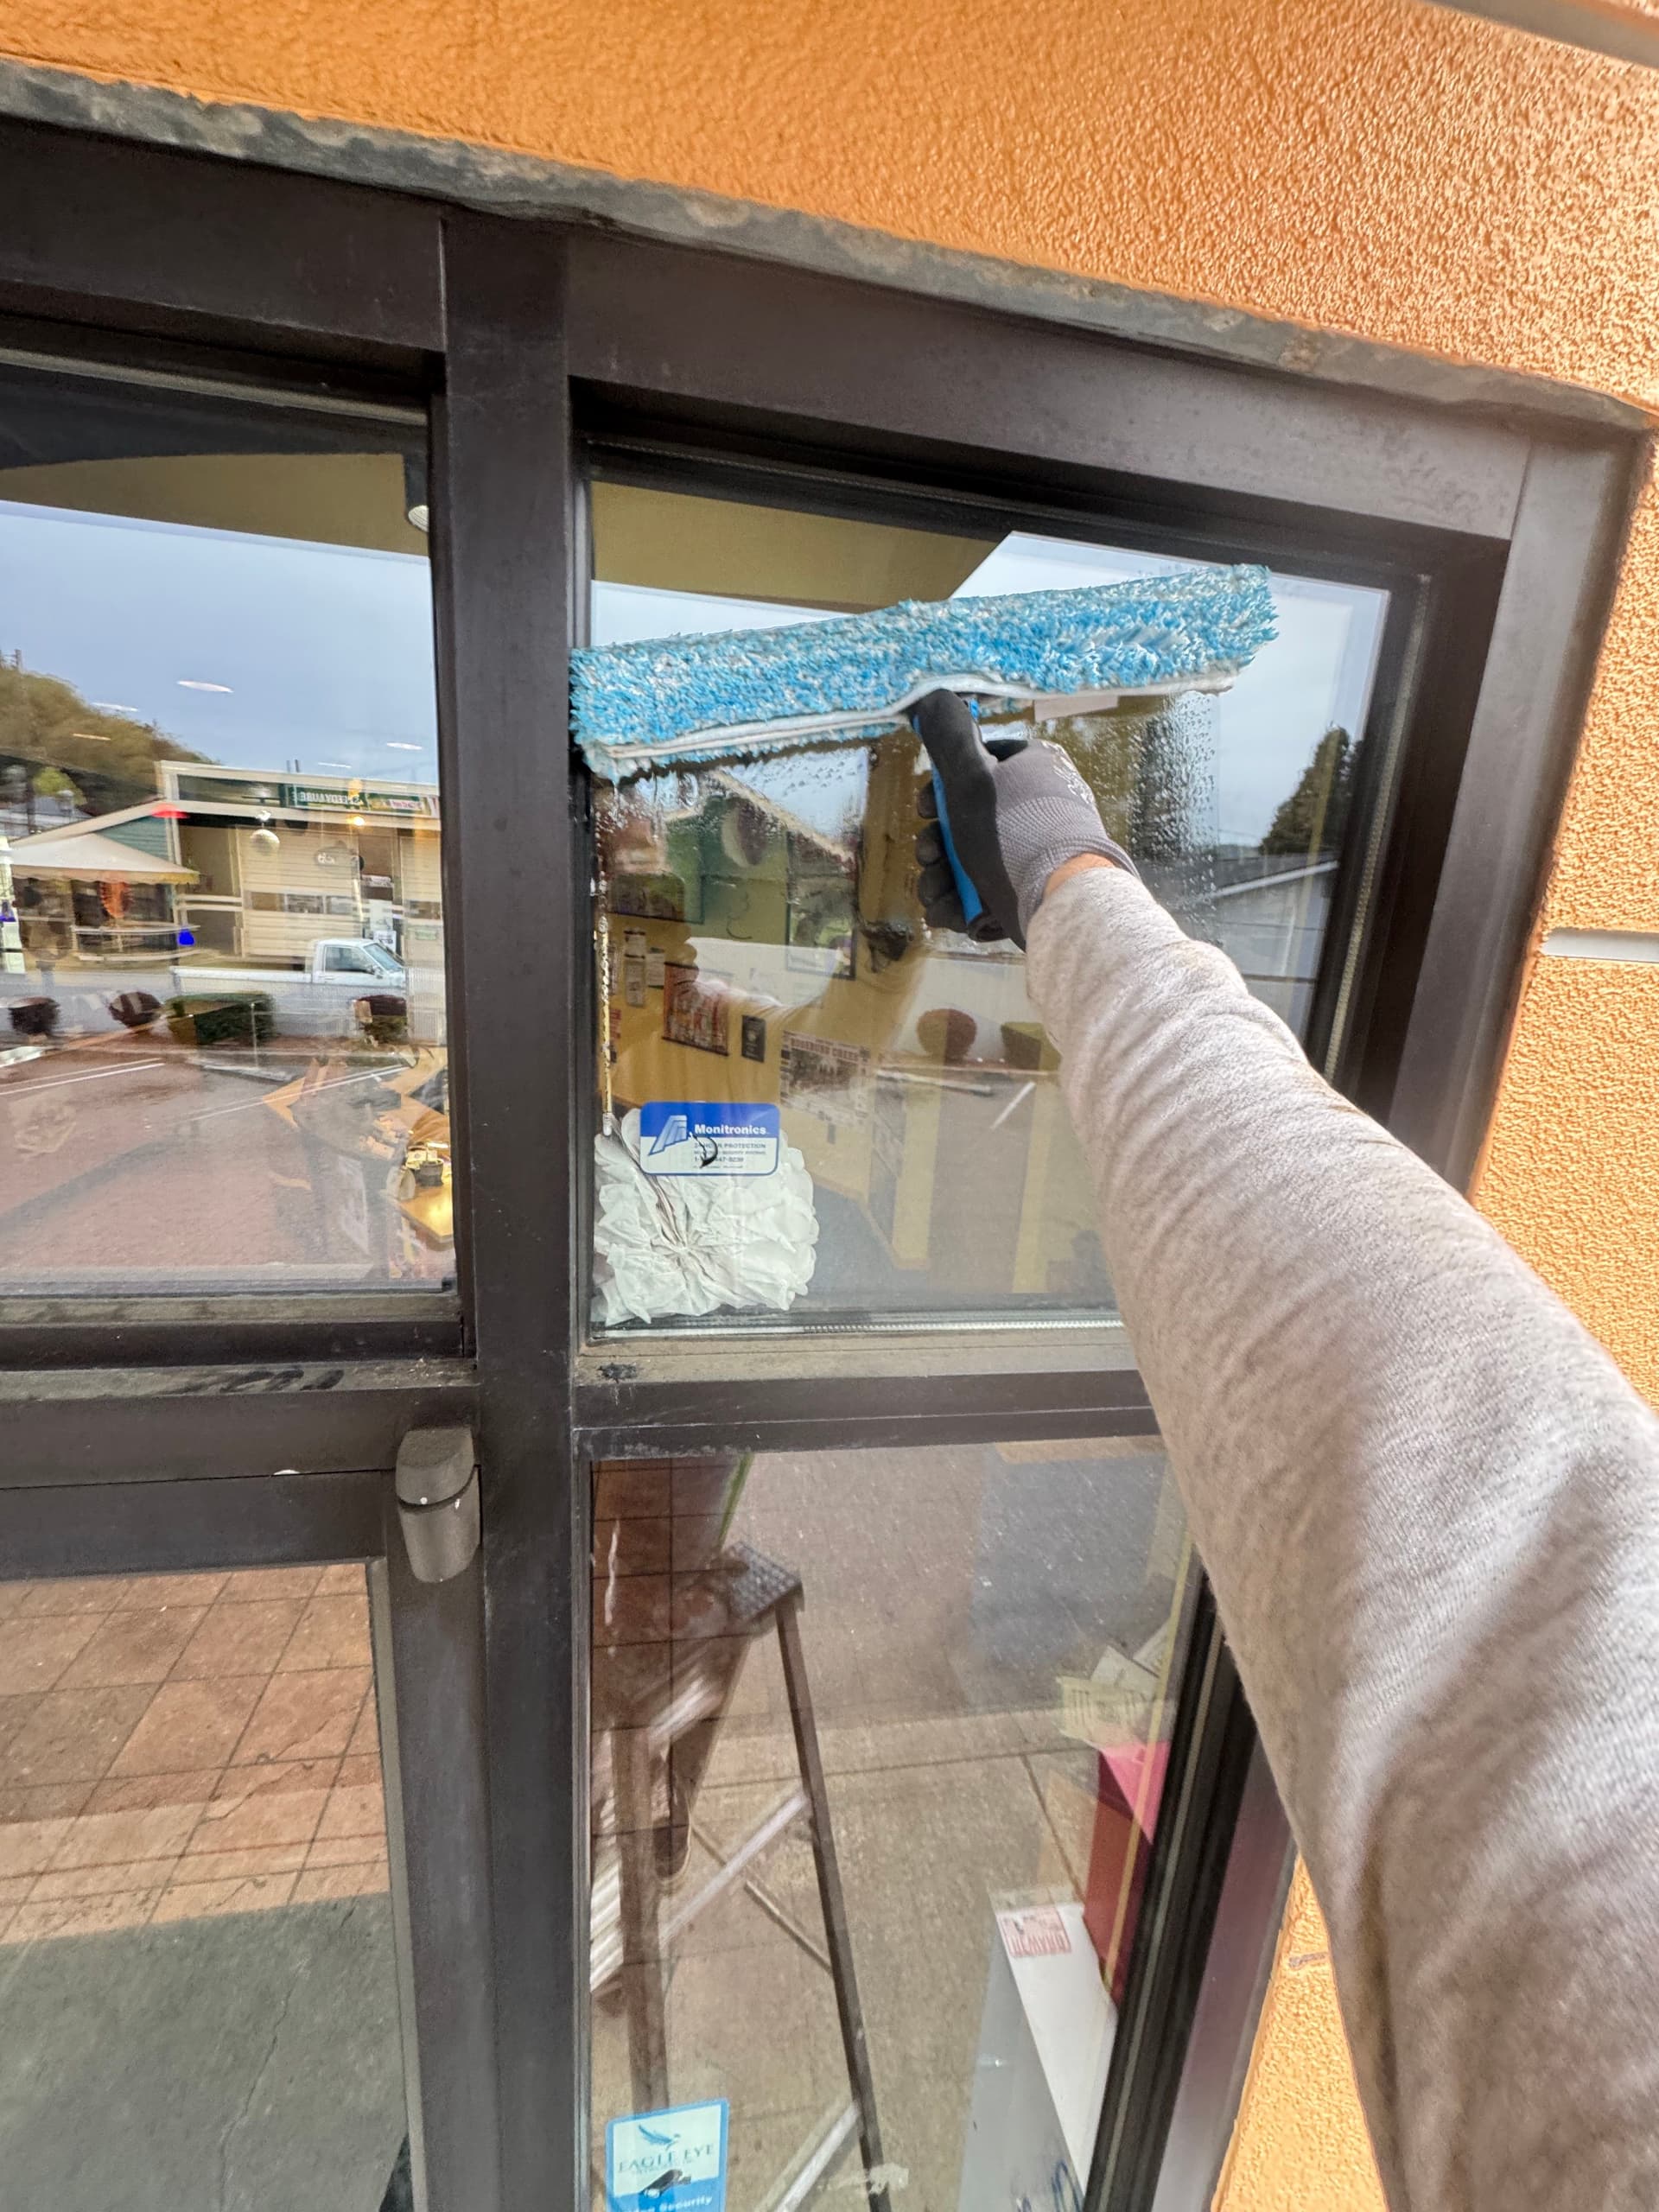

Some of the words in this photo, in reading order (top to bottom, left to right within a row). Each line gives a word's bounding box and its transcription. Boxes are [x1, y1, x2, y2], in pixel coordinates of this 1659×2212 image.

[694, 1124, 766, 1135] Monitronics
[618, 2151, 677, 2173] EAGLE
[683, 2143, 715, 2159] EYE
[659, 2196, 713, 2212] Security
